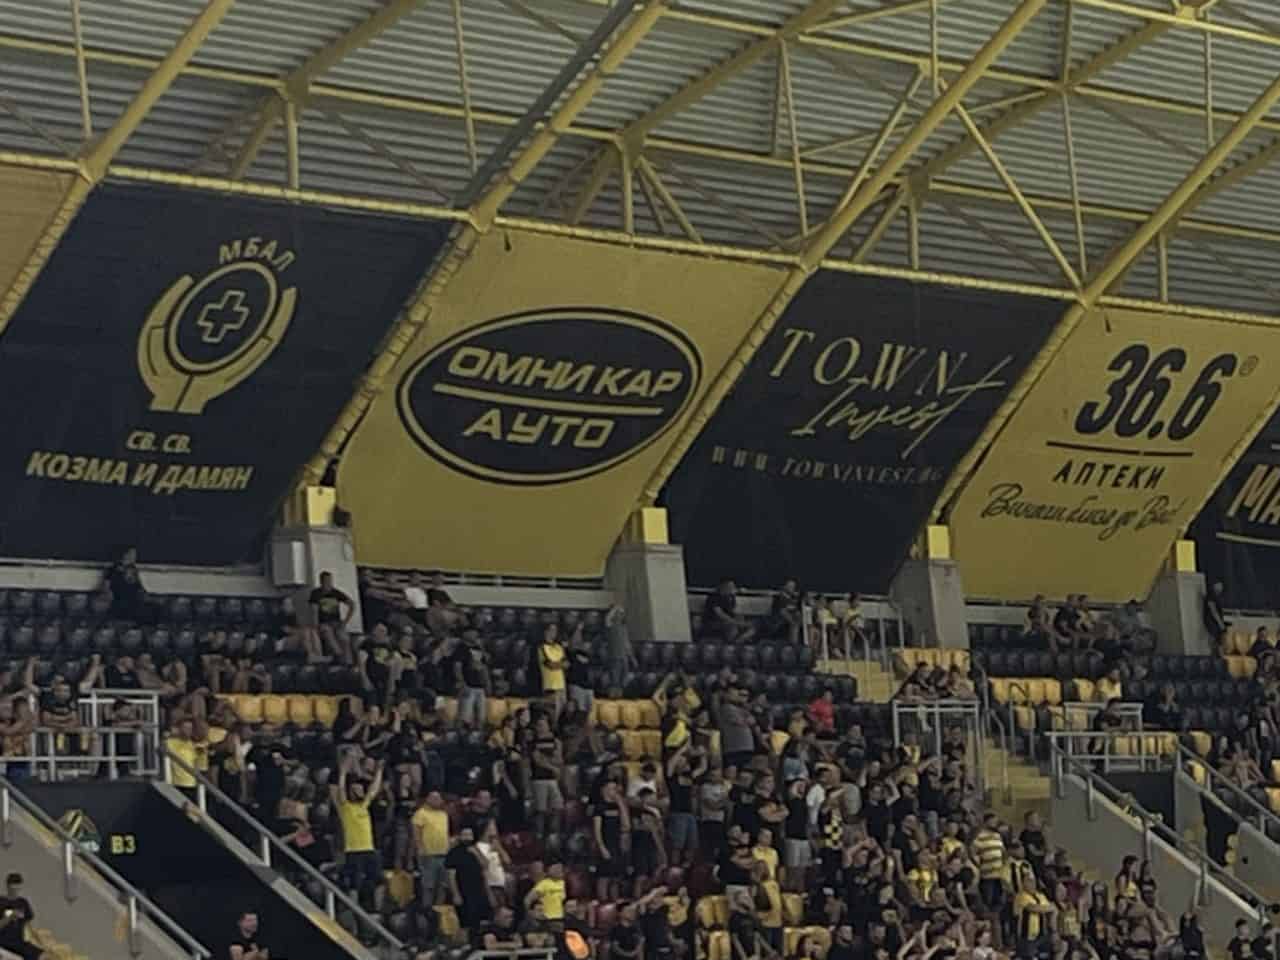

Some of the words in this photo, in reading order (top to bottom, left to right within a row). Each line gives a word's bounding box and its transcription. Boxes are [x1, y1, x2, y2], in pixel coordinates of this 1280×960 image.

[219, 237, 295, 271] МБАЛ
[447, 346, 597, 393] ОМНИ
[592, 366, 684, 397] КАР
[769, 328, 968, 396] TOWN
[1074, 343, 1238, 441] 36.6
[462, 408, 615, 449] АУТО
[26, 451, 128, 485] КОЗМА
[131, 463, 160, 487] И
[152, 464, 254, 495] ДАМЯН
[1052, 459, 1166, 490] АПТЕКИ
